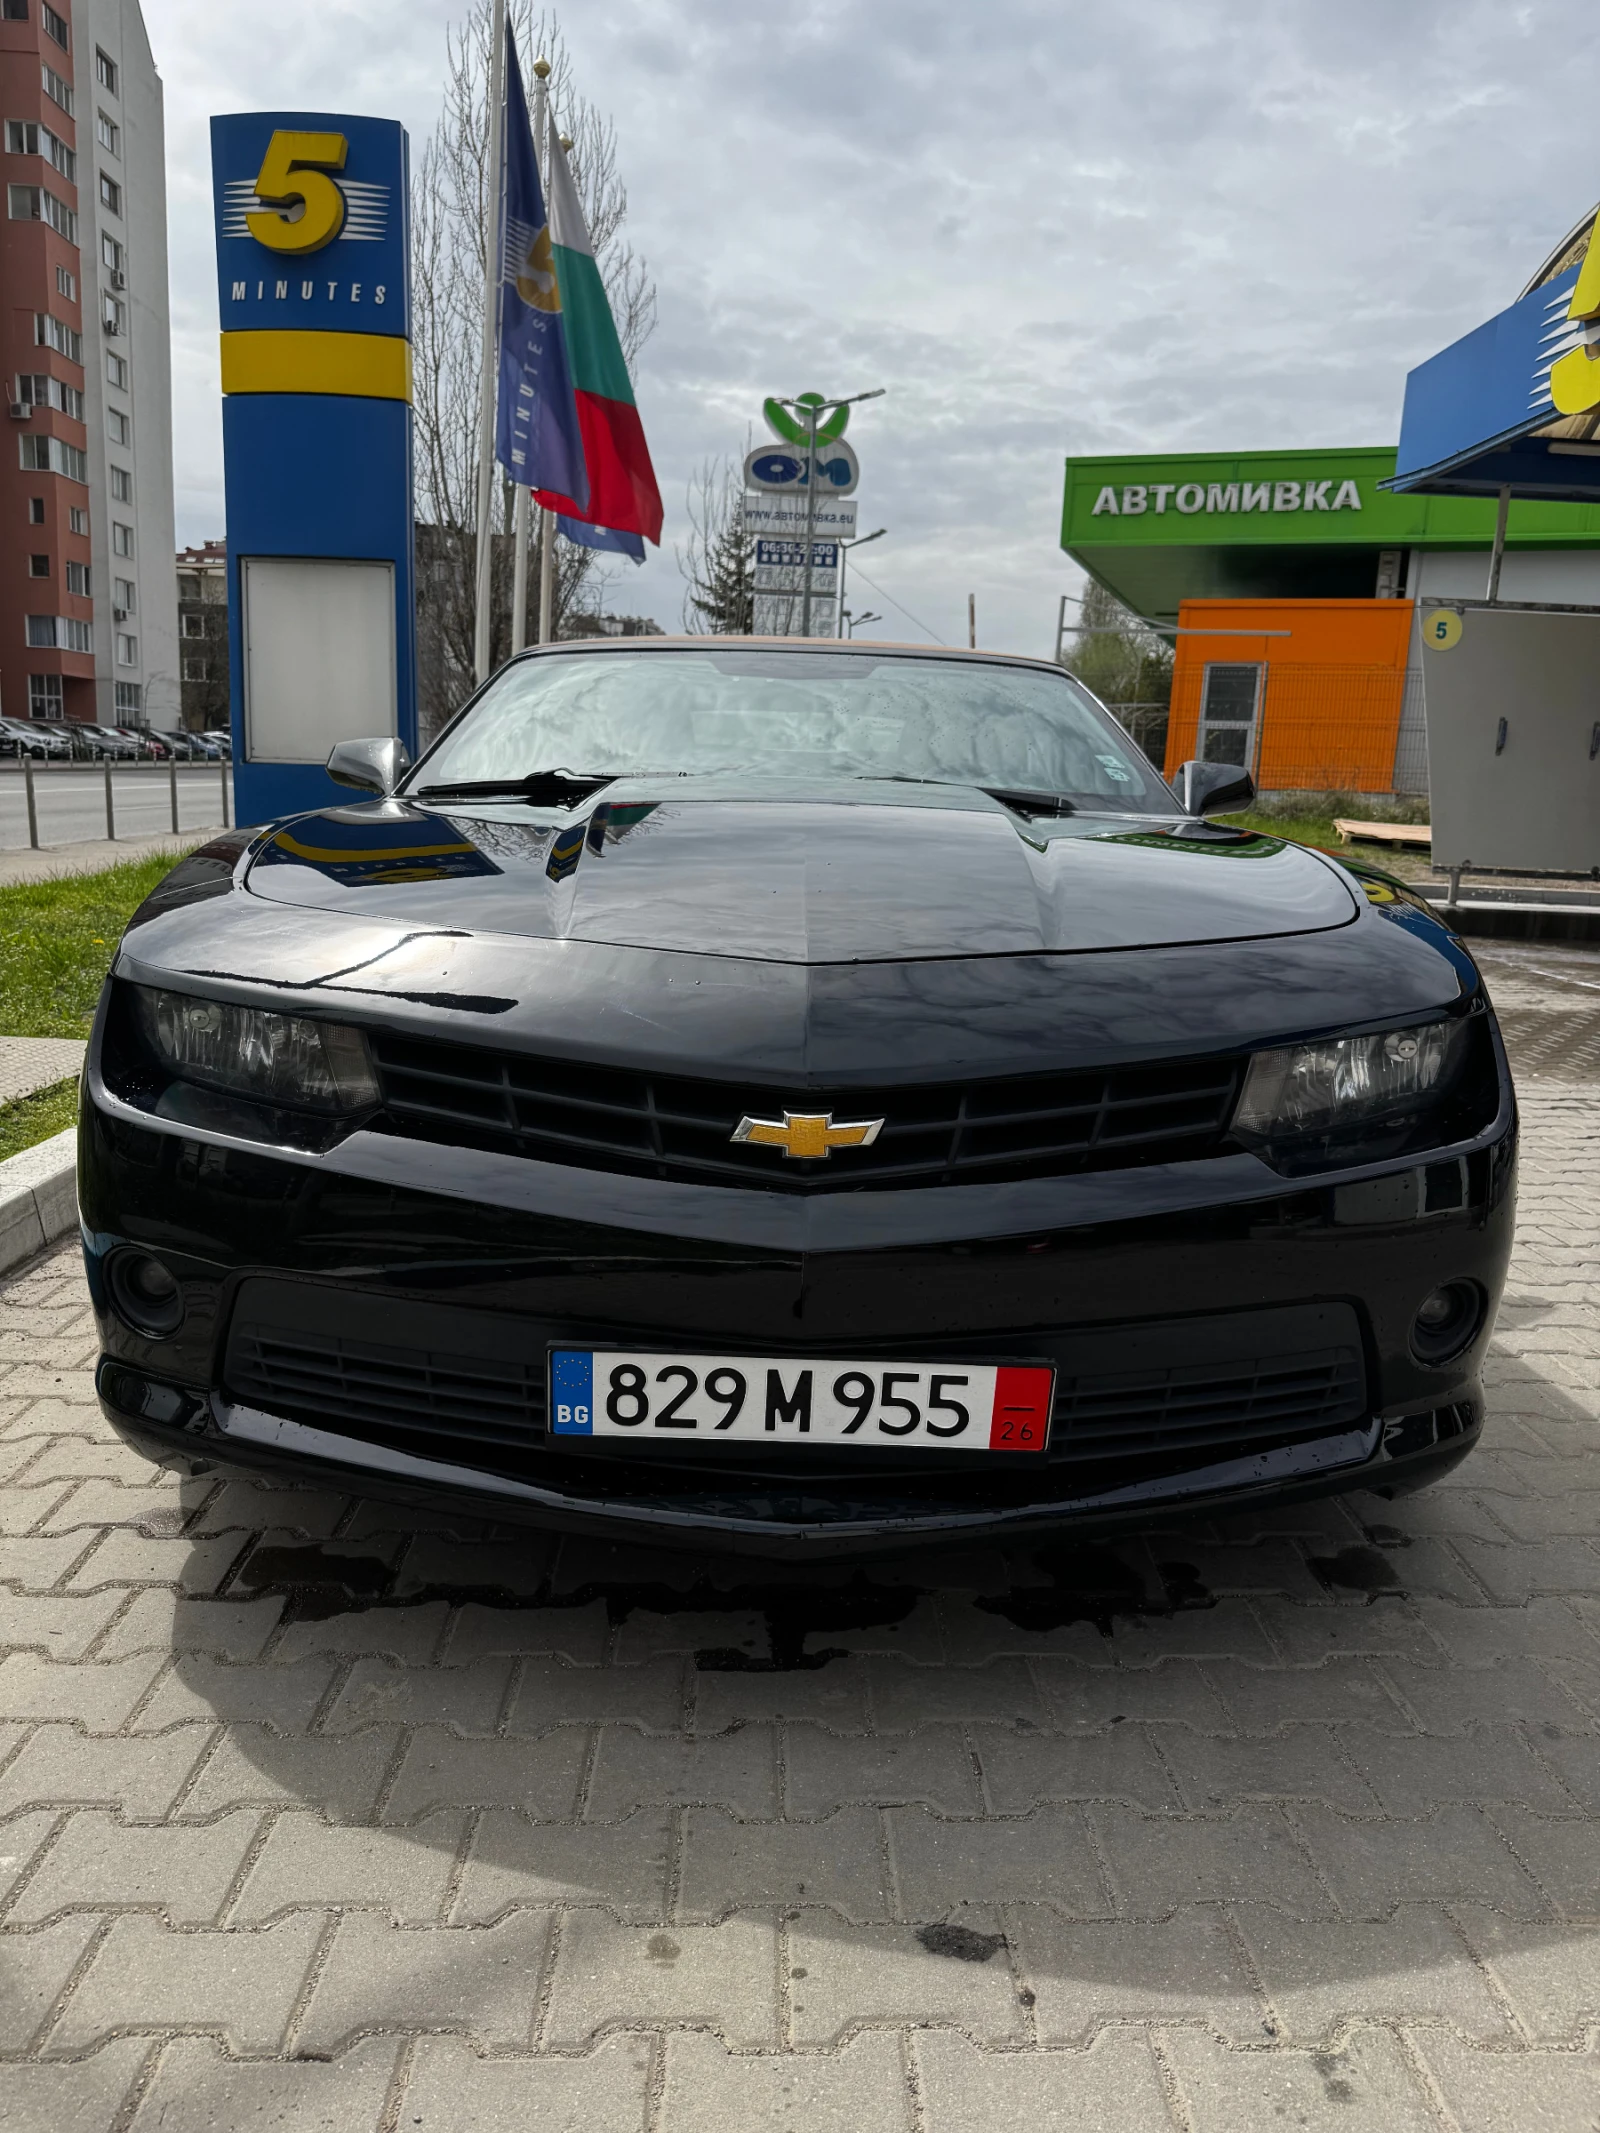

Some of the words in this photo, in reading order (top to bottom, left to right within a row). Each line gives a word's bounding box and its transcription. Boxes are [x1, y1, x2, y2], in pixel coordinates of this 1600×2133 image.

[245, 129, 349, 255] 5
[231, 280, 387, 305] MINUTES
[511, 318, 547, 466] MINUTES
[1091, 480, 1362, 515] АВТОМИВКА
[761, 542, 834, 556] 06:30-2:00
[1435, 621, 1448, 640] 5
[605, 1363, 748, 1431] 829
[832, 1371, 970, 1438] 955
[557, 1404, 589, 1424] BG
[1001, 1421, 1033, 1441] 26
